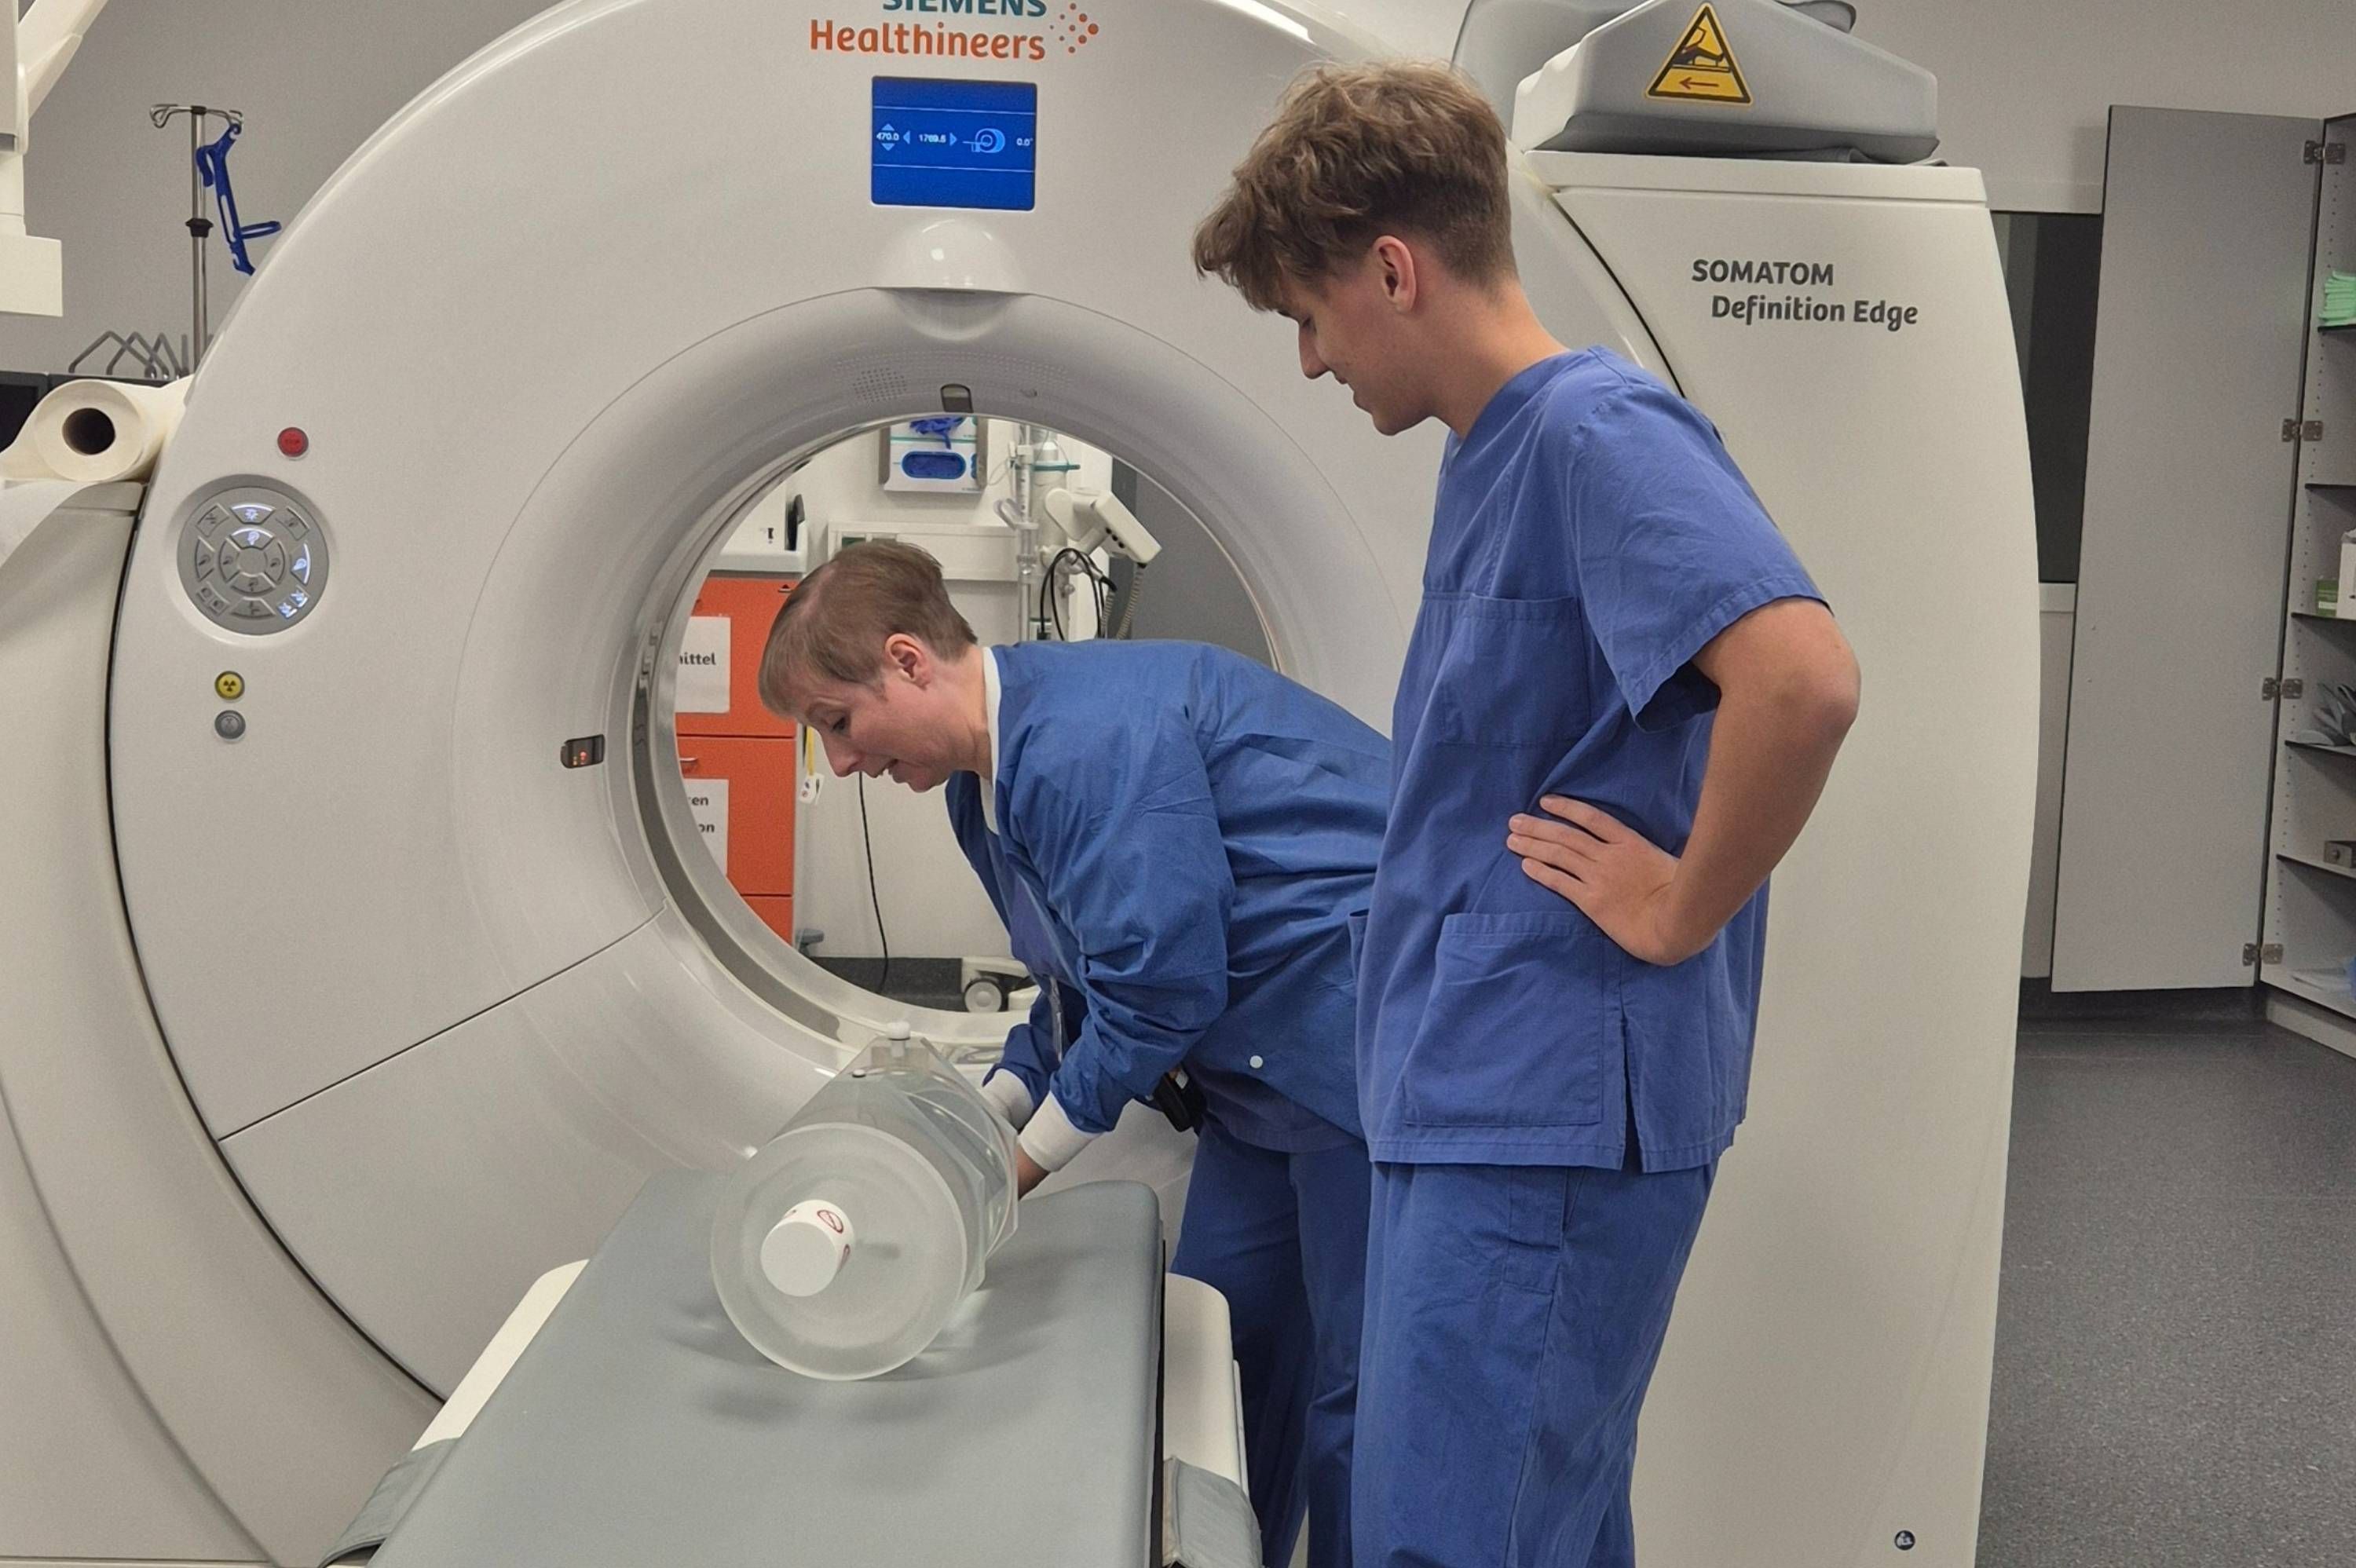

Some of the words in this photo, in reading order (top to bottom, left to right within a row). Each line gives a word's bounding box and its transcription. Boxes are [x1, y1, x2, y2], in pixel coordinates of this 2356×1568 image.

[810, 20, 1045, 60] Healthineers
[1692, 259, 1834, 286] SOMATOM
[1711, 295, 1846, 326] Definition
[1853, 301, 1919, 332] Edge
